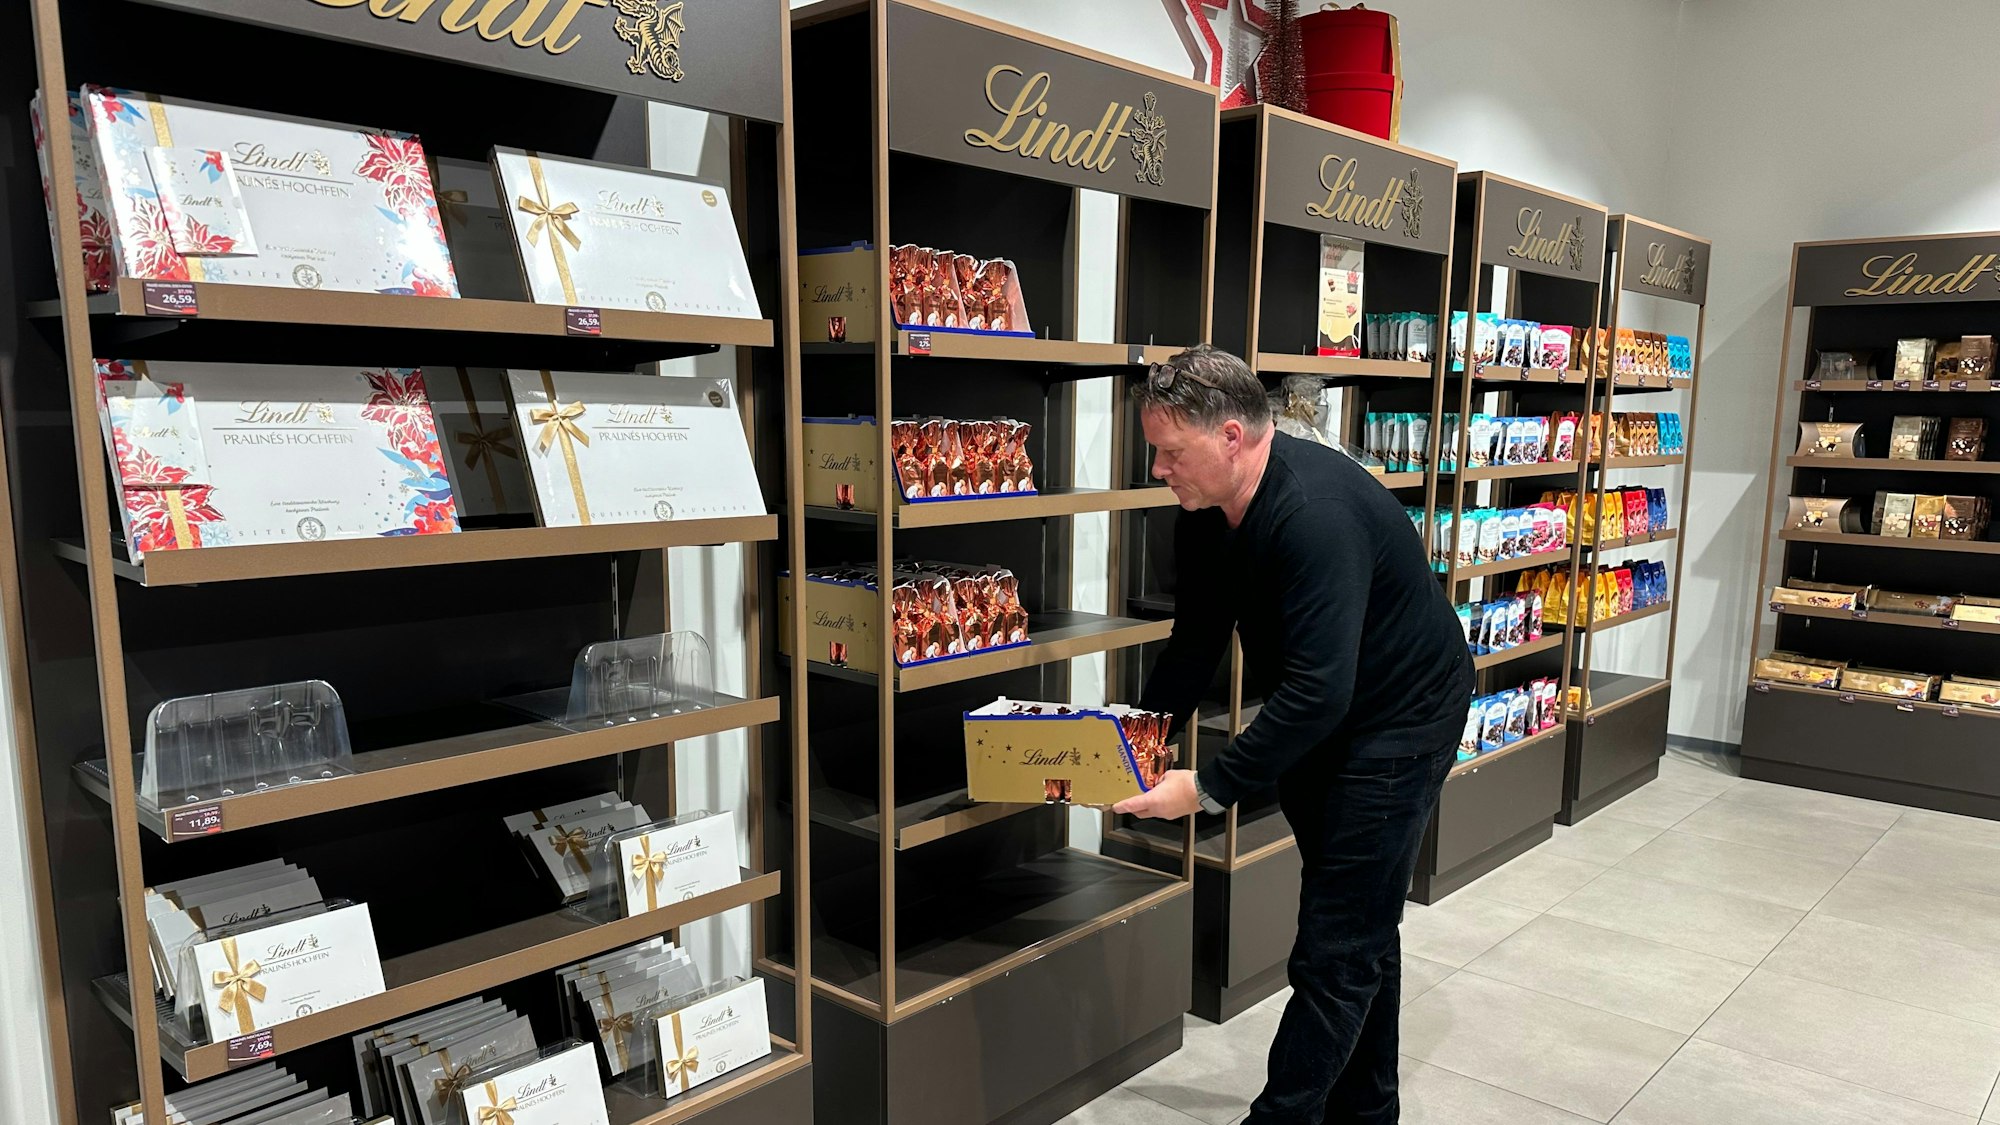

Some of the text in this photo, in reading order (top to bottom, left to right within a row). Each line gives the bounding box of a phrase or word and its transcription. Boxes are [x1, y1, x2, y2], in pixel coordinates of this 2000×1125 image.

[308, 0, 606, 54] ndt
[964, 64, 1134, 173] Lindt
[231, 141, 308, 172] Lindt
[235, 175, 352, 199] ALINÉS HOCHFEIN
[1305, 154, 1402, 231] Lindt
[177, 194, 213, 206] Lindt
[596, 190, 650, 214] Lindt
[1507, 206, 1571, 266] Lindt
[1640, 242, 1685, 290] Lindt
[1844, 252, 1998, 297] Lindt
[162, 294, 196, 305] 26,59€
[812, 285, 845, 303] Lindt
[234, 400, 313, 424] Lindt
[604, 402, 657, 424] Lindt
[223, 431, 353, 445] PRALINÉS HOCHFEIN
[599, 430, 688, 441] PRALINÉS HOCHFEIN
[820, 453, 852, 471] Lindt
[812, 610, 846, 630] Lindt
[1019, 748, 1069, 766] Lindt
[1116, 744, 1134, 775] MANDEL
[583, 825, 607, 840] Lindt
[667, 839, 693, 856] Lindt
[223, 908, 261, 925] Lindt
[264, 937, 306, 962] Lindt
[258, 950, 330, 977] PRALINÉS HOCHFEIN
[635, 991, 660, 1008] Lindt
[700, 1011, 726, 1029] Lindt
[517, 1080, 548, 1101] Lindt
